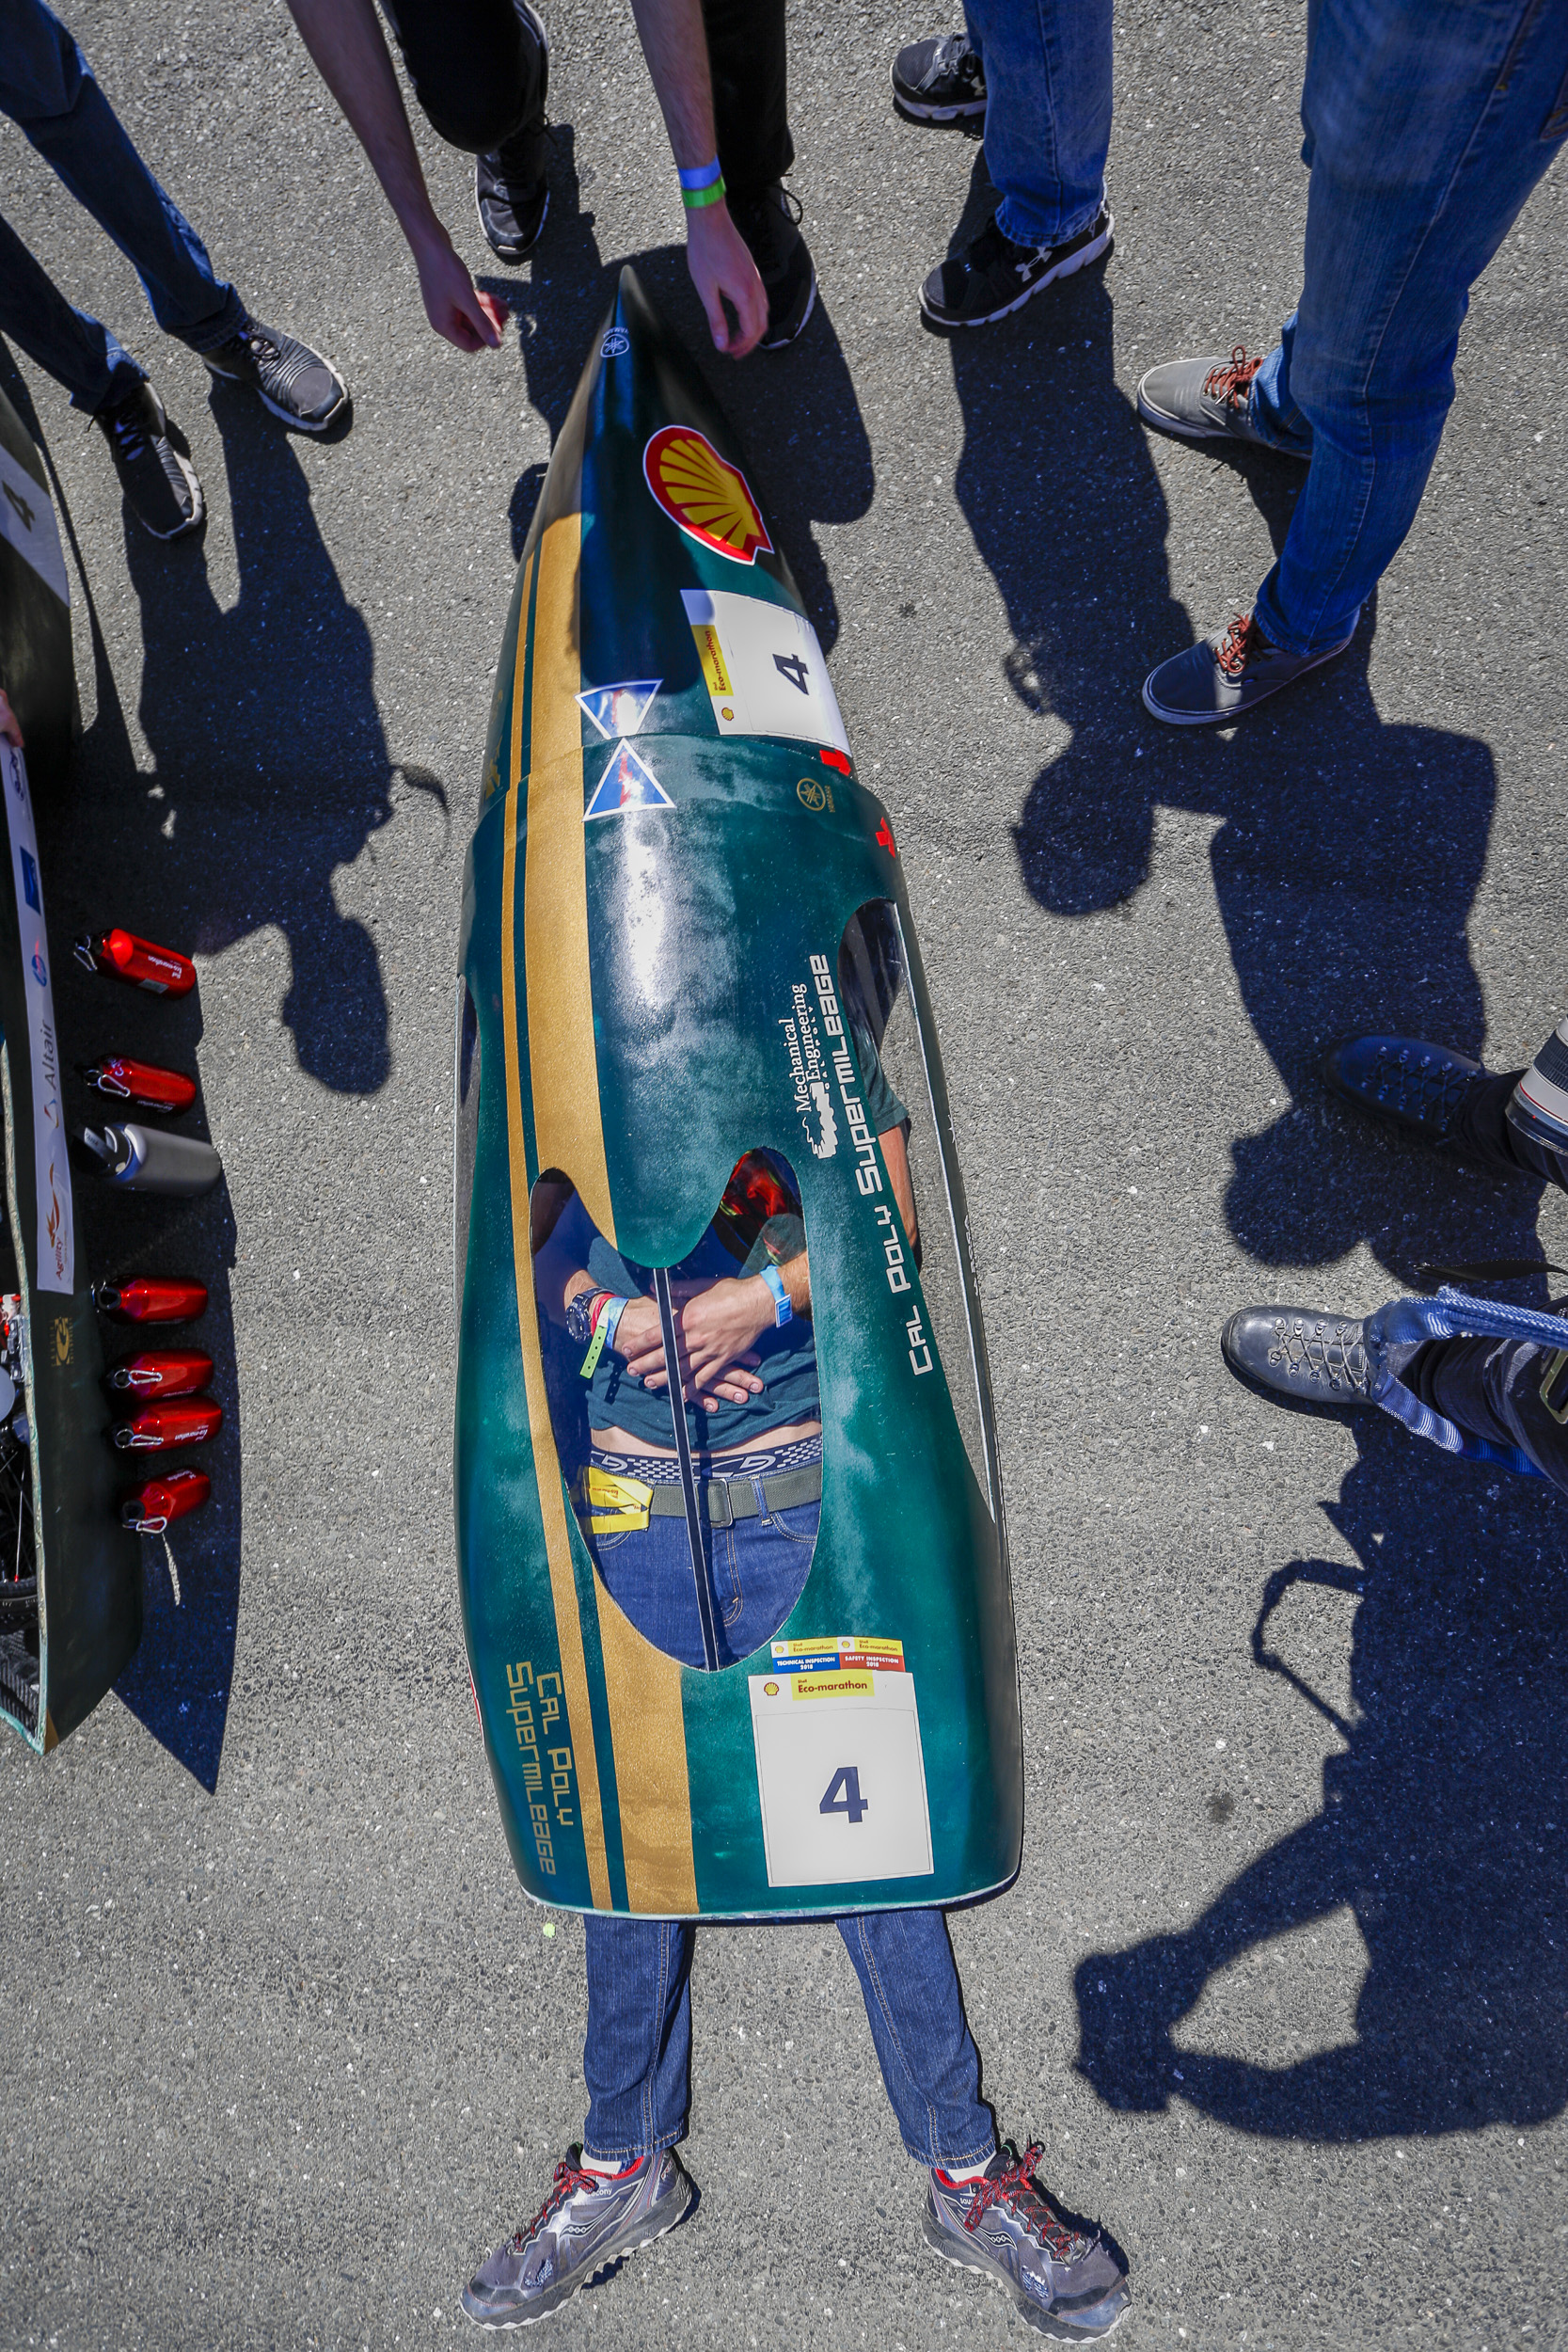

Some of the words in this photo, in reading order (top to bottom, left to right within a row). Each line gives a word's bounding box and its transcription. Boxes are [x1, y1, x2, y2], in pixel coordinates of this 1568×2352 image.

[2, 479, 36, 533] 4
[705, 630, 727, 691] Eco-marathon
[772, 653, 810, 695] 4
[40, 1019, 57, 1090] Altair
[791, 983, 821, 1081] Engineering
[779, 1017, 812, 1113] Mechanical
[777, 1659, 804, 1667] TECHNICAL
[793, 1645, 833, 1653] Eco-marathon
[859, 1644, 898, 1652] Eco-marathon
[866, 1656, 899, 1664] INSPECTION
[798, 1680, 867, 1693] Eco-marathon
[819, 1766, 869, 1823] 4
